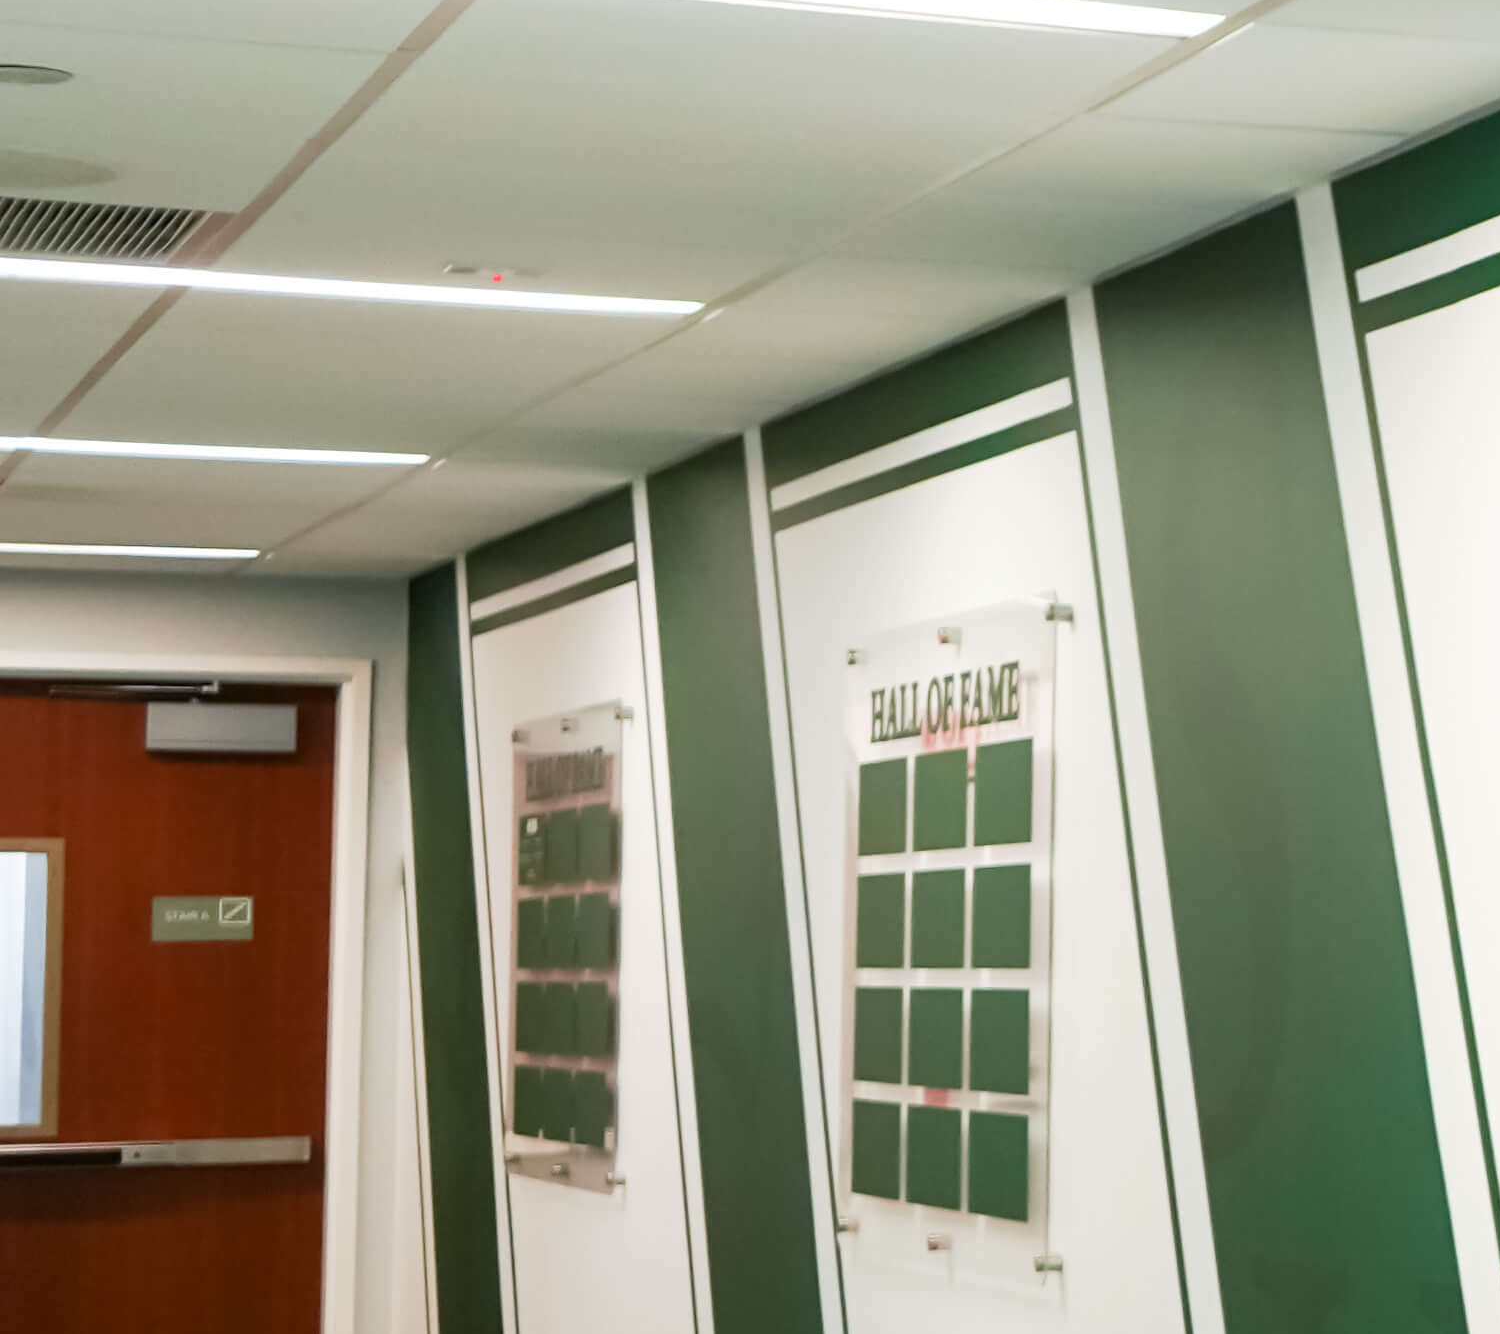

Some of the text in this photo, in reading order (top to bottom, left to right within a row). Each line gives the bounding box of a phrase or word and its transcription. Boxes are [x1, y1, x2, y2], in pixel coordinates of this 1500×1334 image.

[870, 661, 1019, 743] HALL OF FAME
